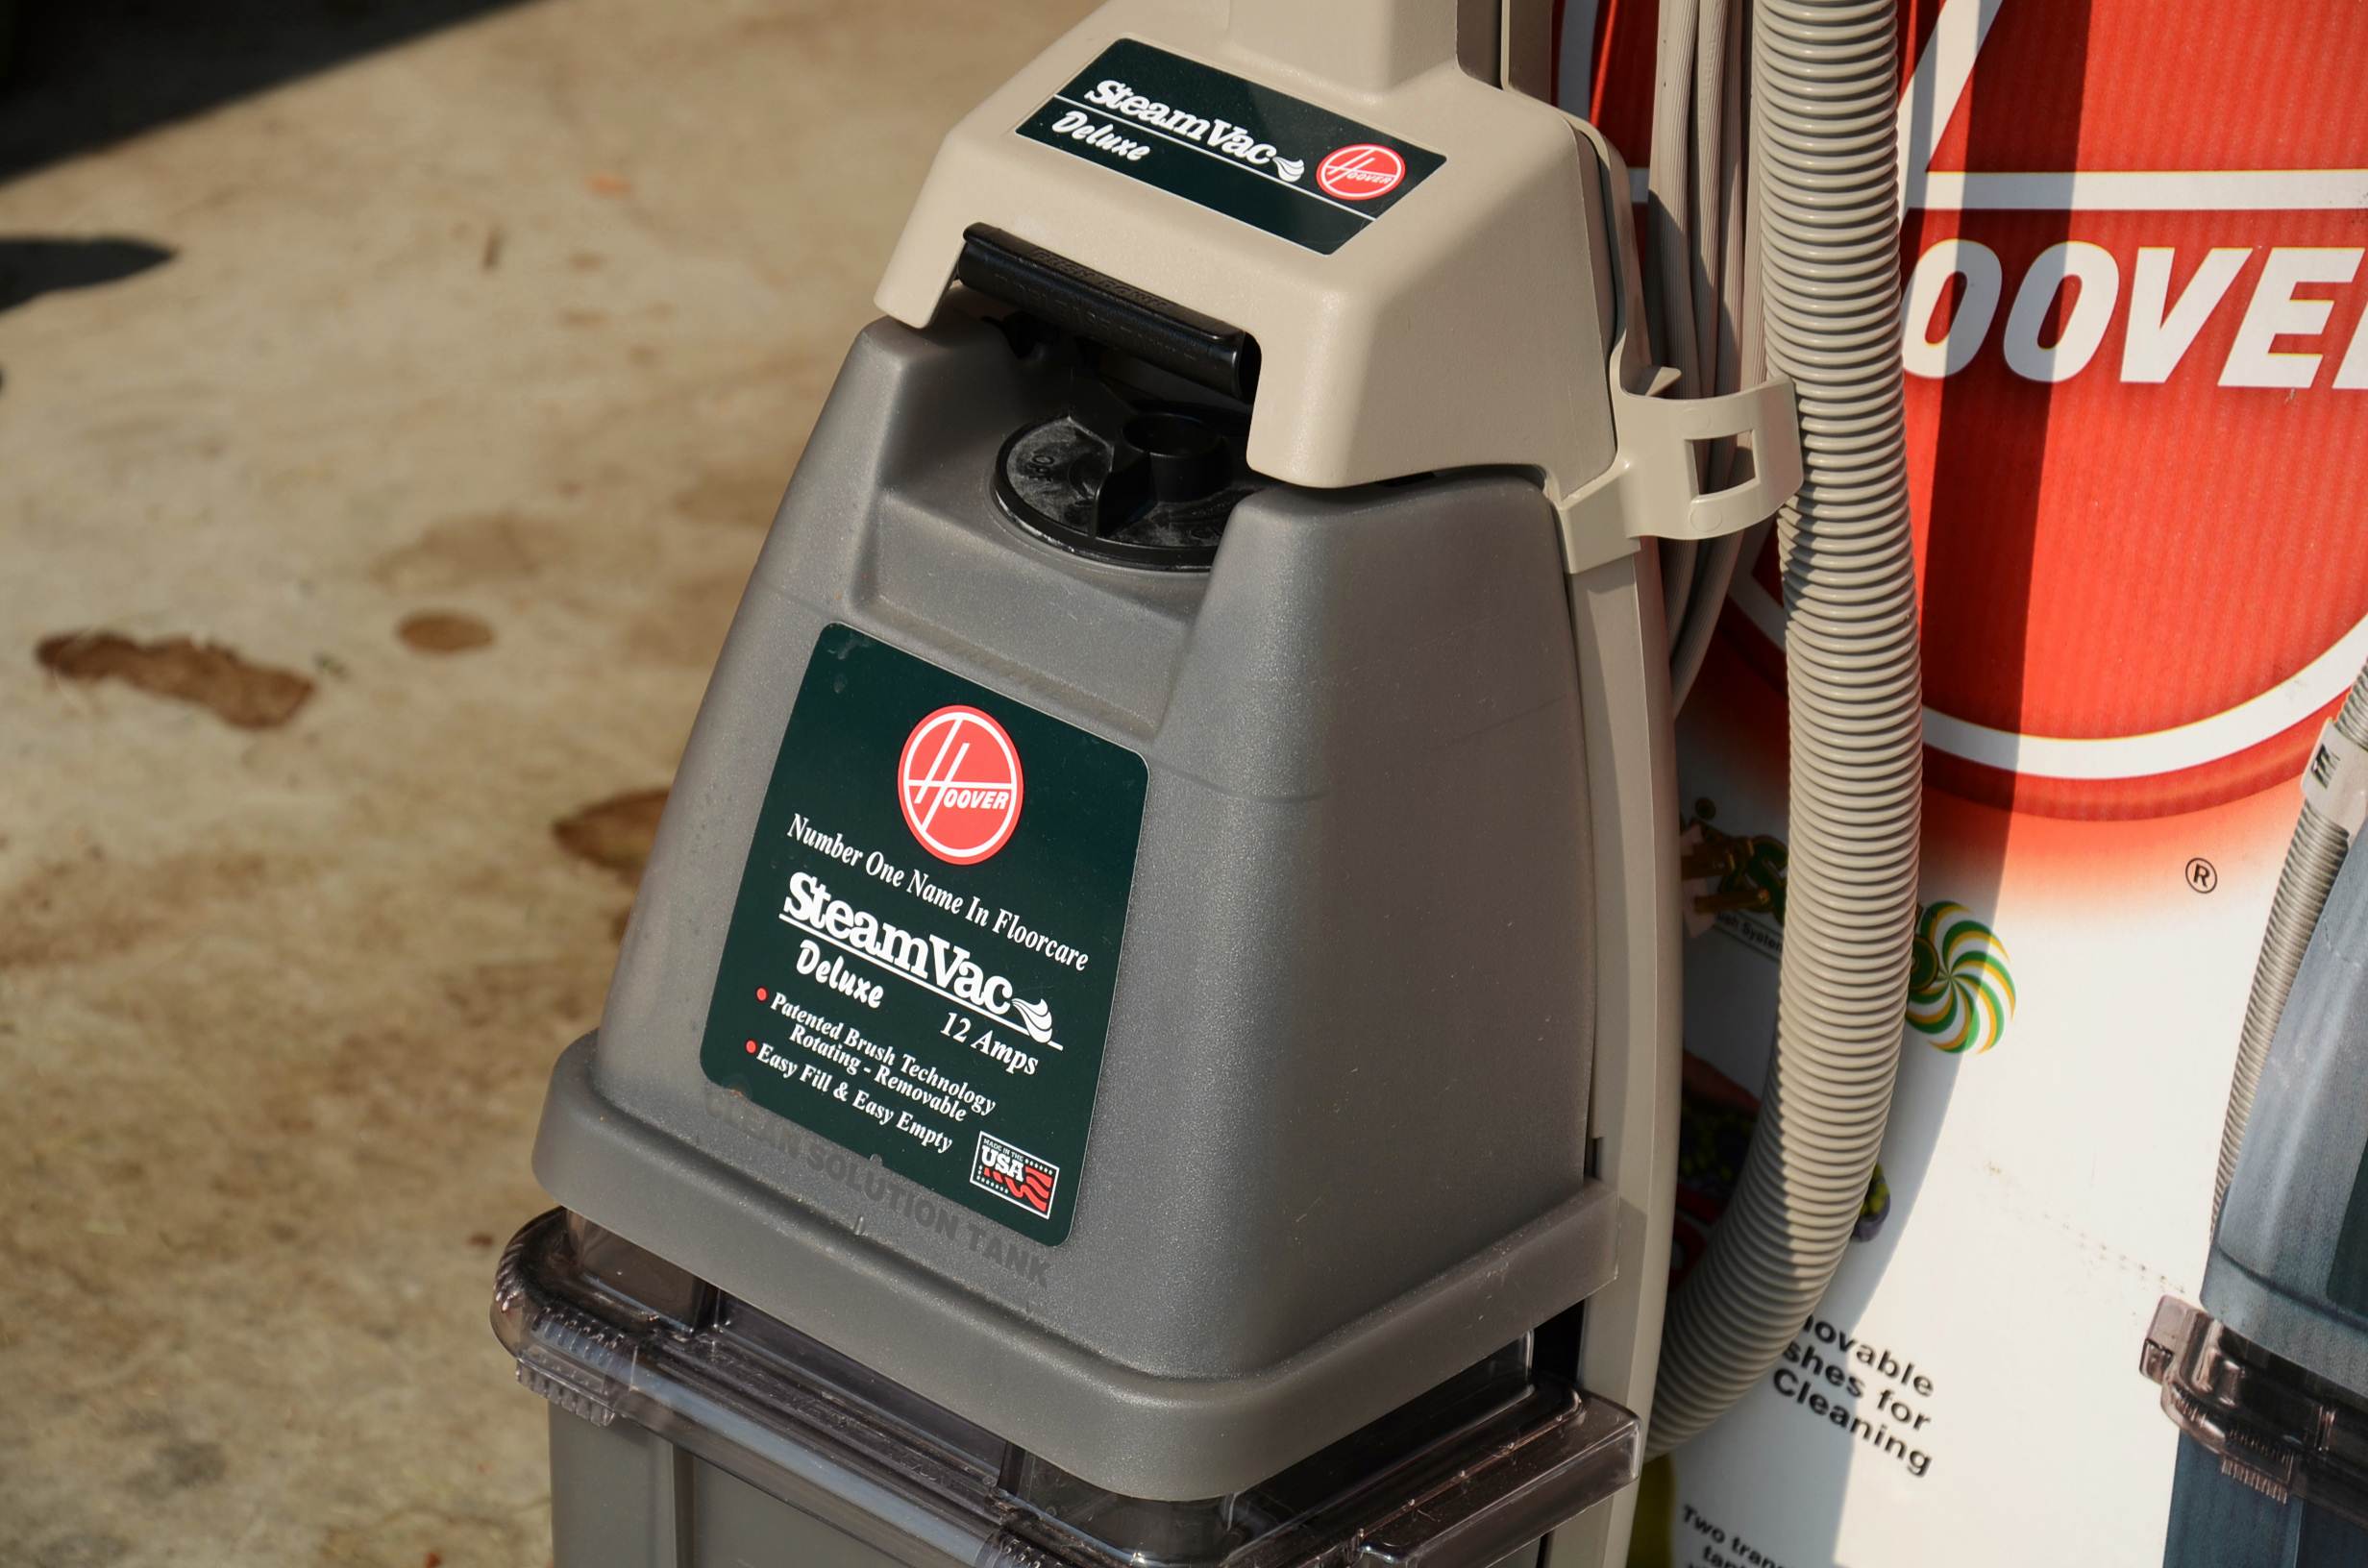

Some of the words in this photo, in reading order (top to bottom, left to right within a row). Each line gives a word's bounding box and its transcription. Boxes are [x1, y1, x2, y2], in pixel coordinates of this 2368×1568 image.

[1051, 110, 1151, 161] Deluxe
[1084, 79, 1276, 165] SteamVac
[1900, 238, 2368, 389] OOVE
[786, 813, 864, 867] Number
[866, 850, 905, 888] One
[906, 869, 964, 915] Name
[965, 895, 989, 927] In
[992, 908, 1090, 971] Floorcare
[783, 870, 1014, 1016] SteamVac
[796, 939, 884, 1009] Deluxe
[770, 992, 841, 1041] Patented
[846, 1028, 896, 1066] Brush
[902, 1053, 997, 1116] Technology
[789, 1024, 862, 1076] Rotating
[874, 1065, 968, 1122] Removable
[940, 1012, 972, 1044] 12
[970, 1029, 1039, 1075] Amps
[755, 1042, 798, 1079] Easy
[800, 1061, 833, 1092] Fill
[832, 1082, 849, 1102] &
[851, 1088, 894, 1126] Easy
[896, 1111, 953, 1153] Empty
[981, 1143, 1025, 1183] USA
[983, 1138, 1002, 1152] MADE
[1002, 1147, 1011, 1156] IN
[1011, 1151, 1024, 1163] THE
[806, 1142, 959, 1240] SOLUTION
[968, 1222, 1051, 1288] TANK
[1783, 1341, 1866, 1399] shes
[1876, 1388, 1932, 1432] for
[1803, 1313, 1935, 1398] ovable
[1773, 1368, 1933, 1477] Cleaning
[1684, 1504, 1726, 1544] Two
[1731, 1536, 1785, 1568] tran
